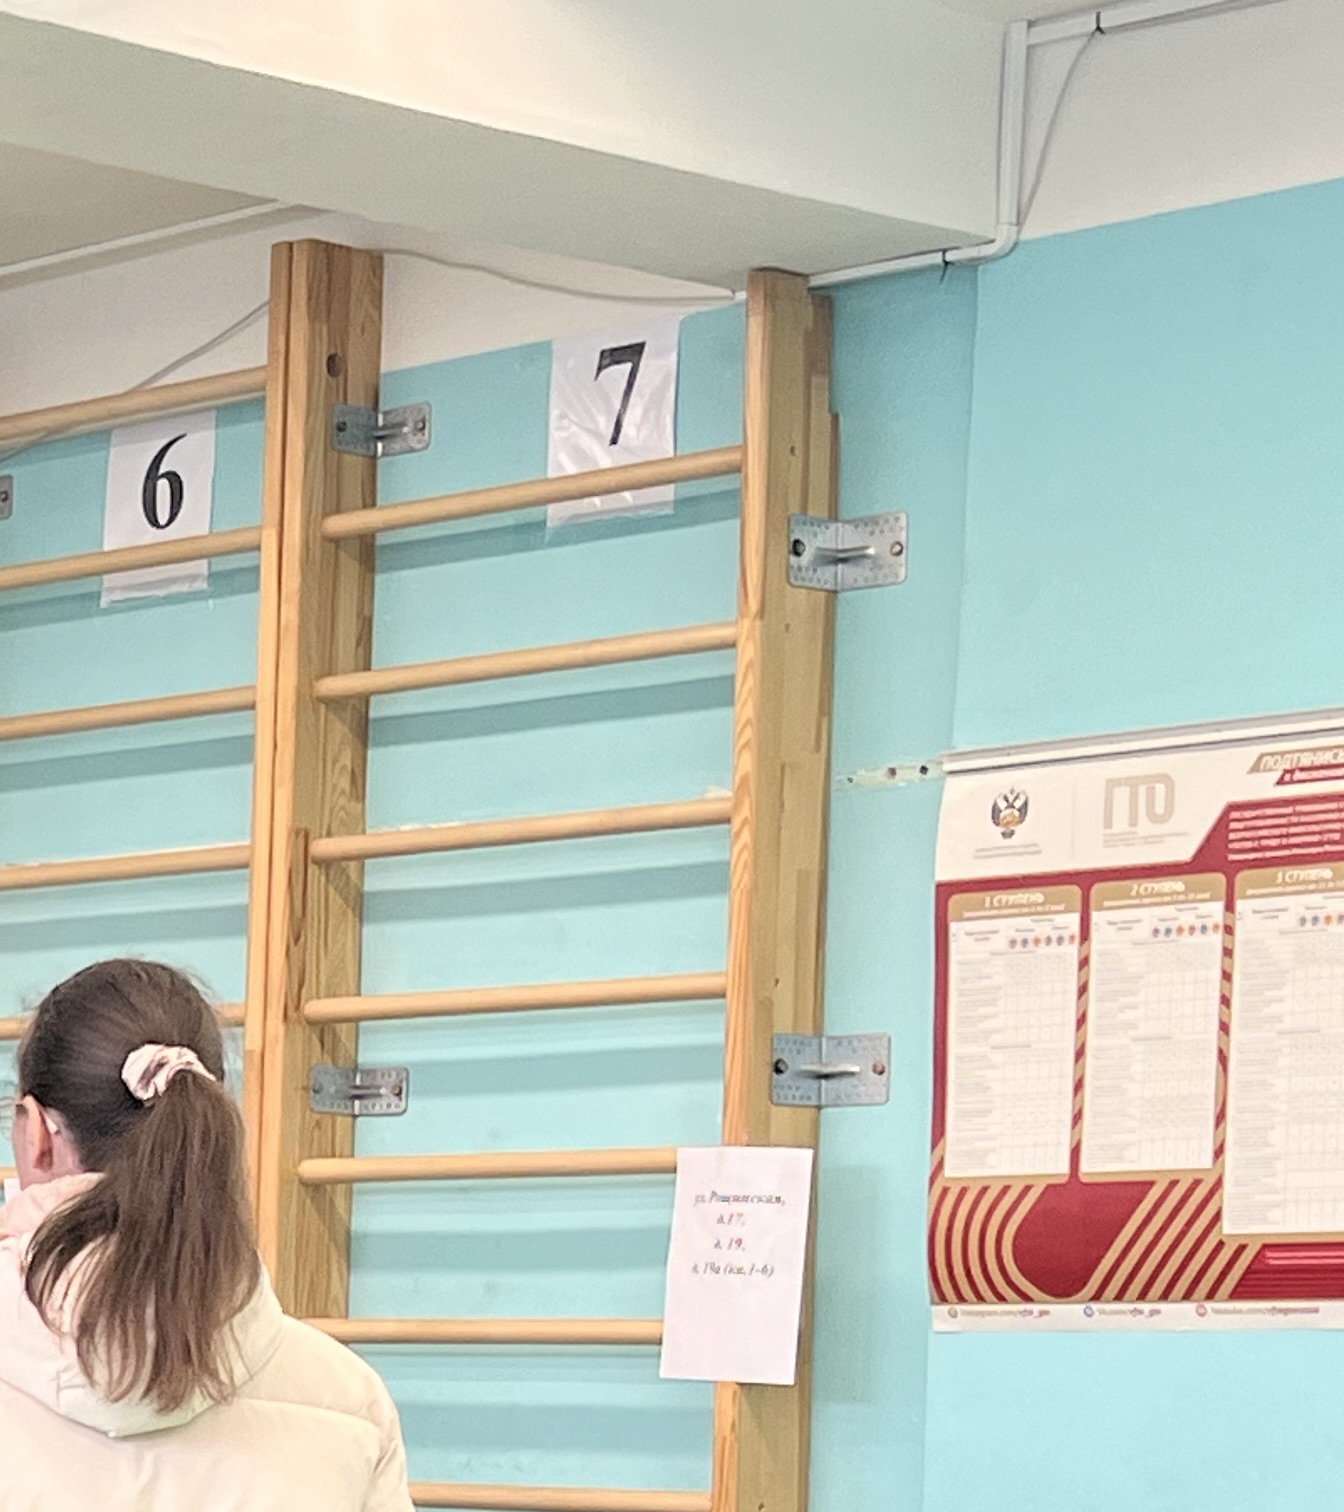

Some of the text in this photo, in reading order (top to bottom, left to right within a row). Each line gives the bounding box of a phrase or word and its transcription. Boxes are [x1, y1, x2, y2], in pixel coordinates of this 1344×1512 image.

[594, 341, 647, 447] 7
[142, 432, 188, 531] 6
[1103, 773, 1176, 831] ГТО
